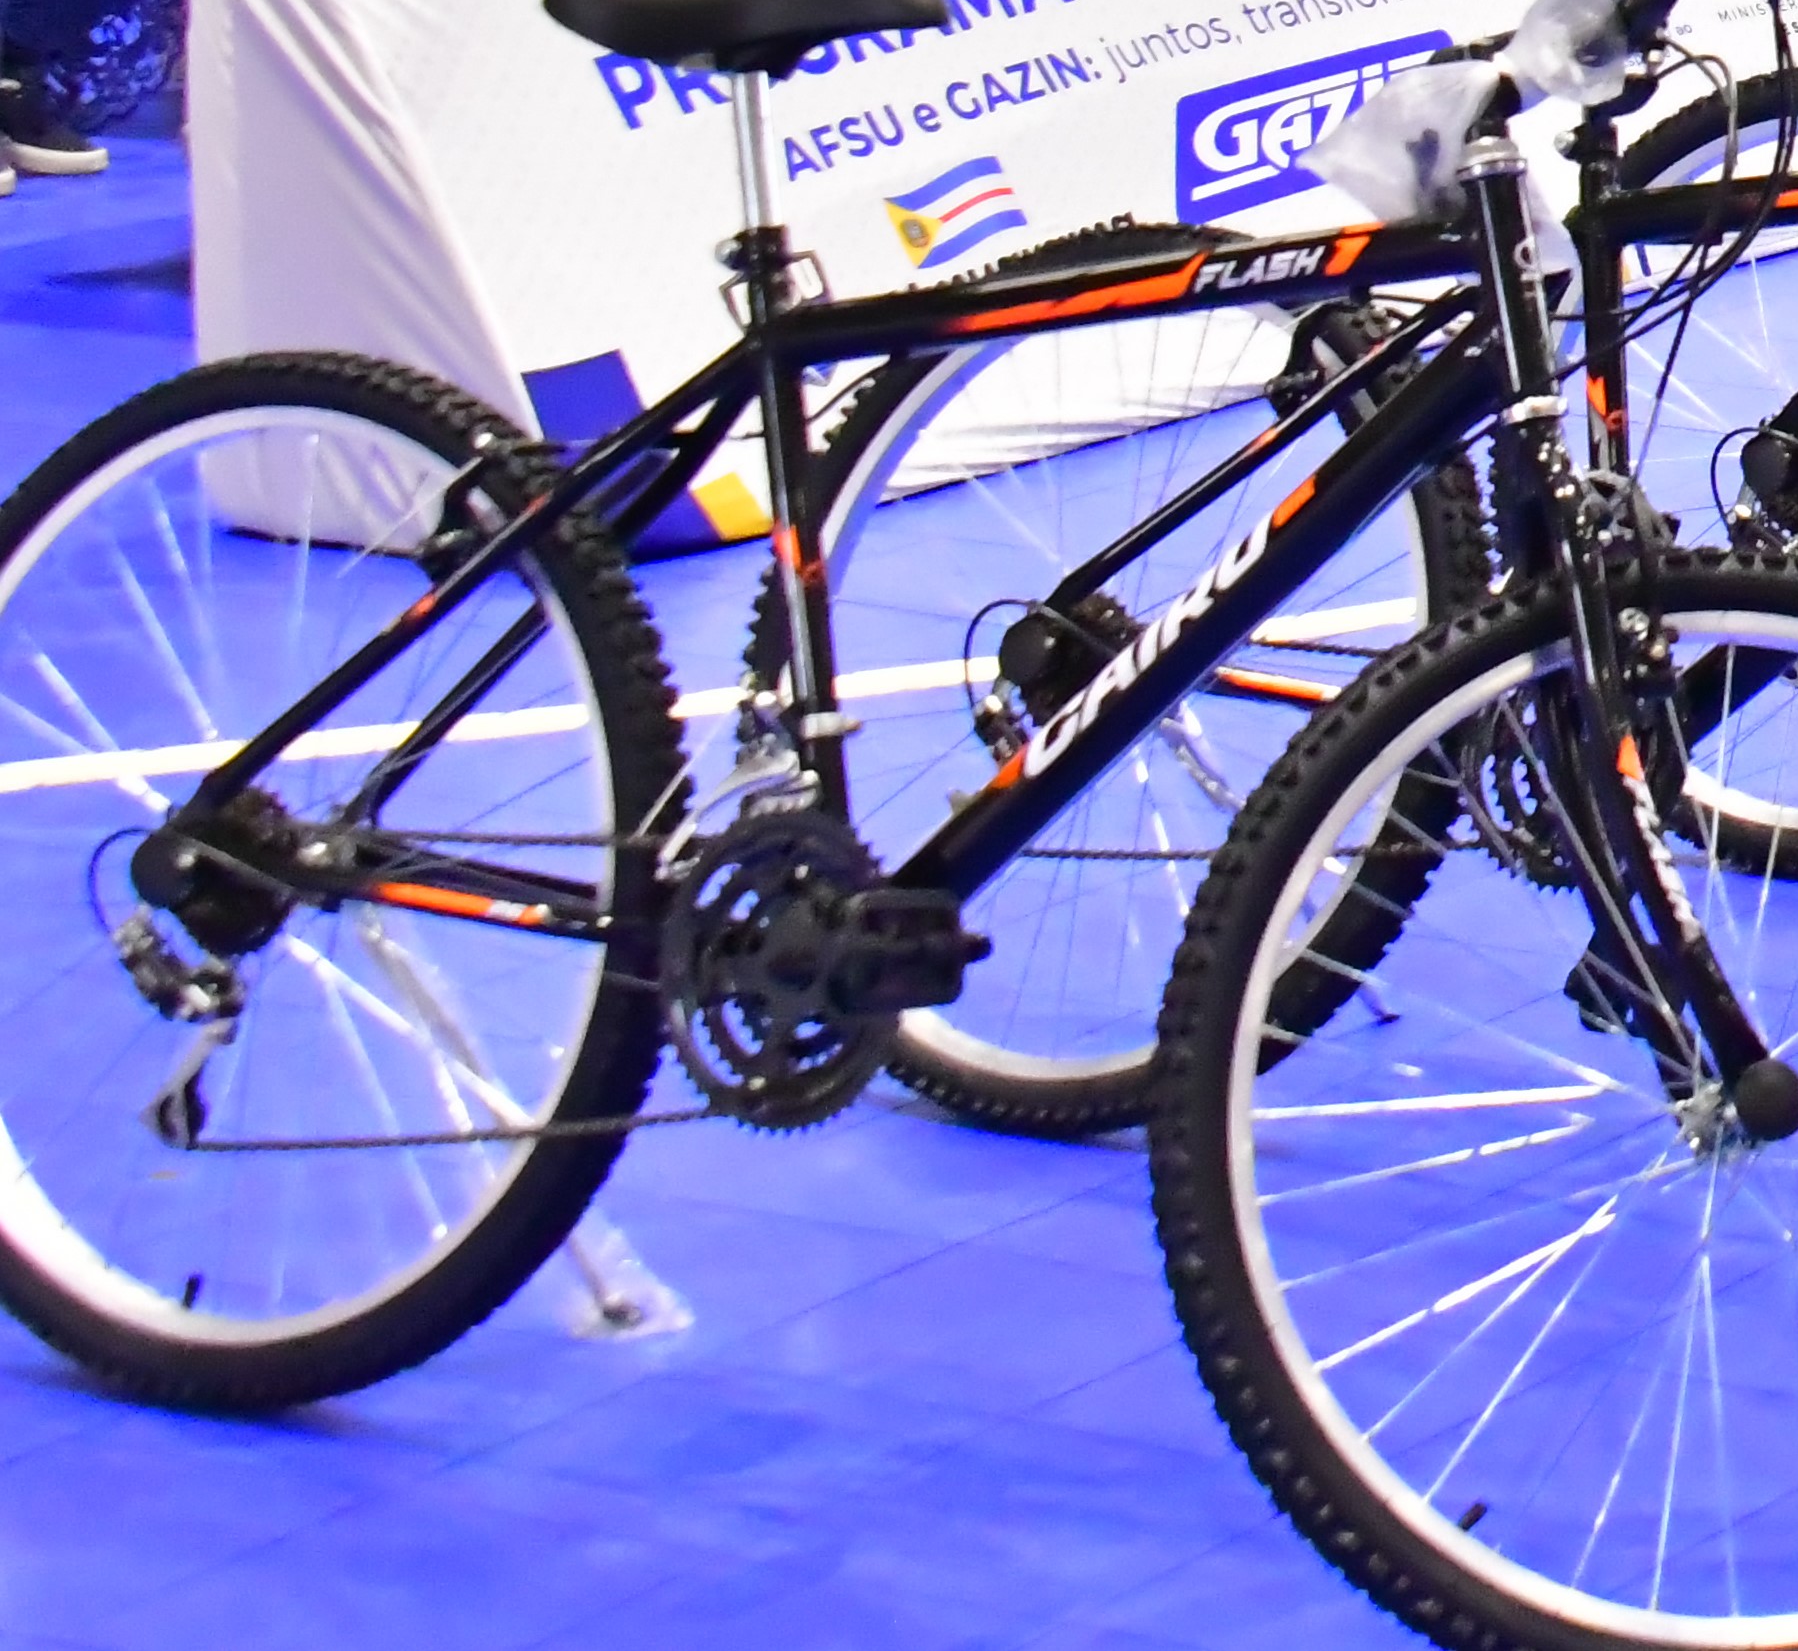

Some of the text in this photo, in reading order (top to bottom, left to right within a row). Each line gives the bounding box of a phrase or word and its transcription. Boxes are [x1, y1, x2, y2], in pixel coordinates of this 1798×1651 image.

[783, 104, 905, 182] AFSU
[912, 102, 942, 133] e
[944, 47, 1103, 121] GAZIN:
[1098, 11, 1243, 85] juntos,
[1191, 50, 1437, 174] GAZ
[1195, 243, 1325, 294] FLASH
